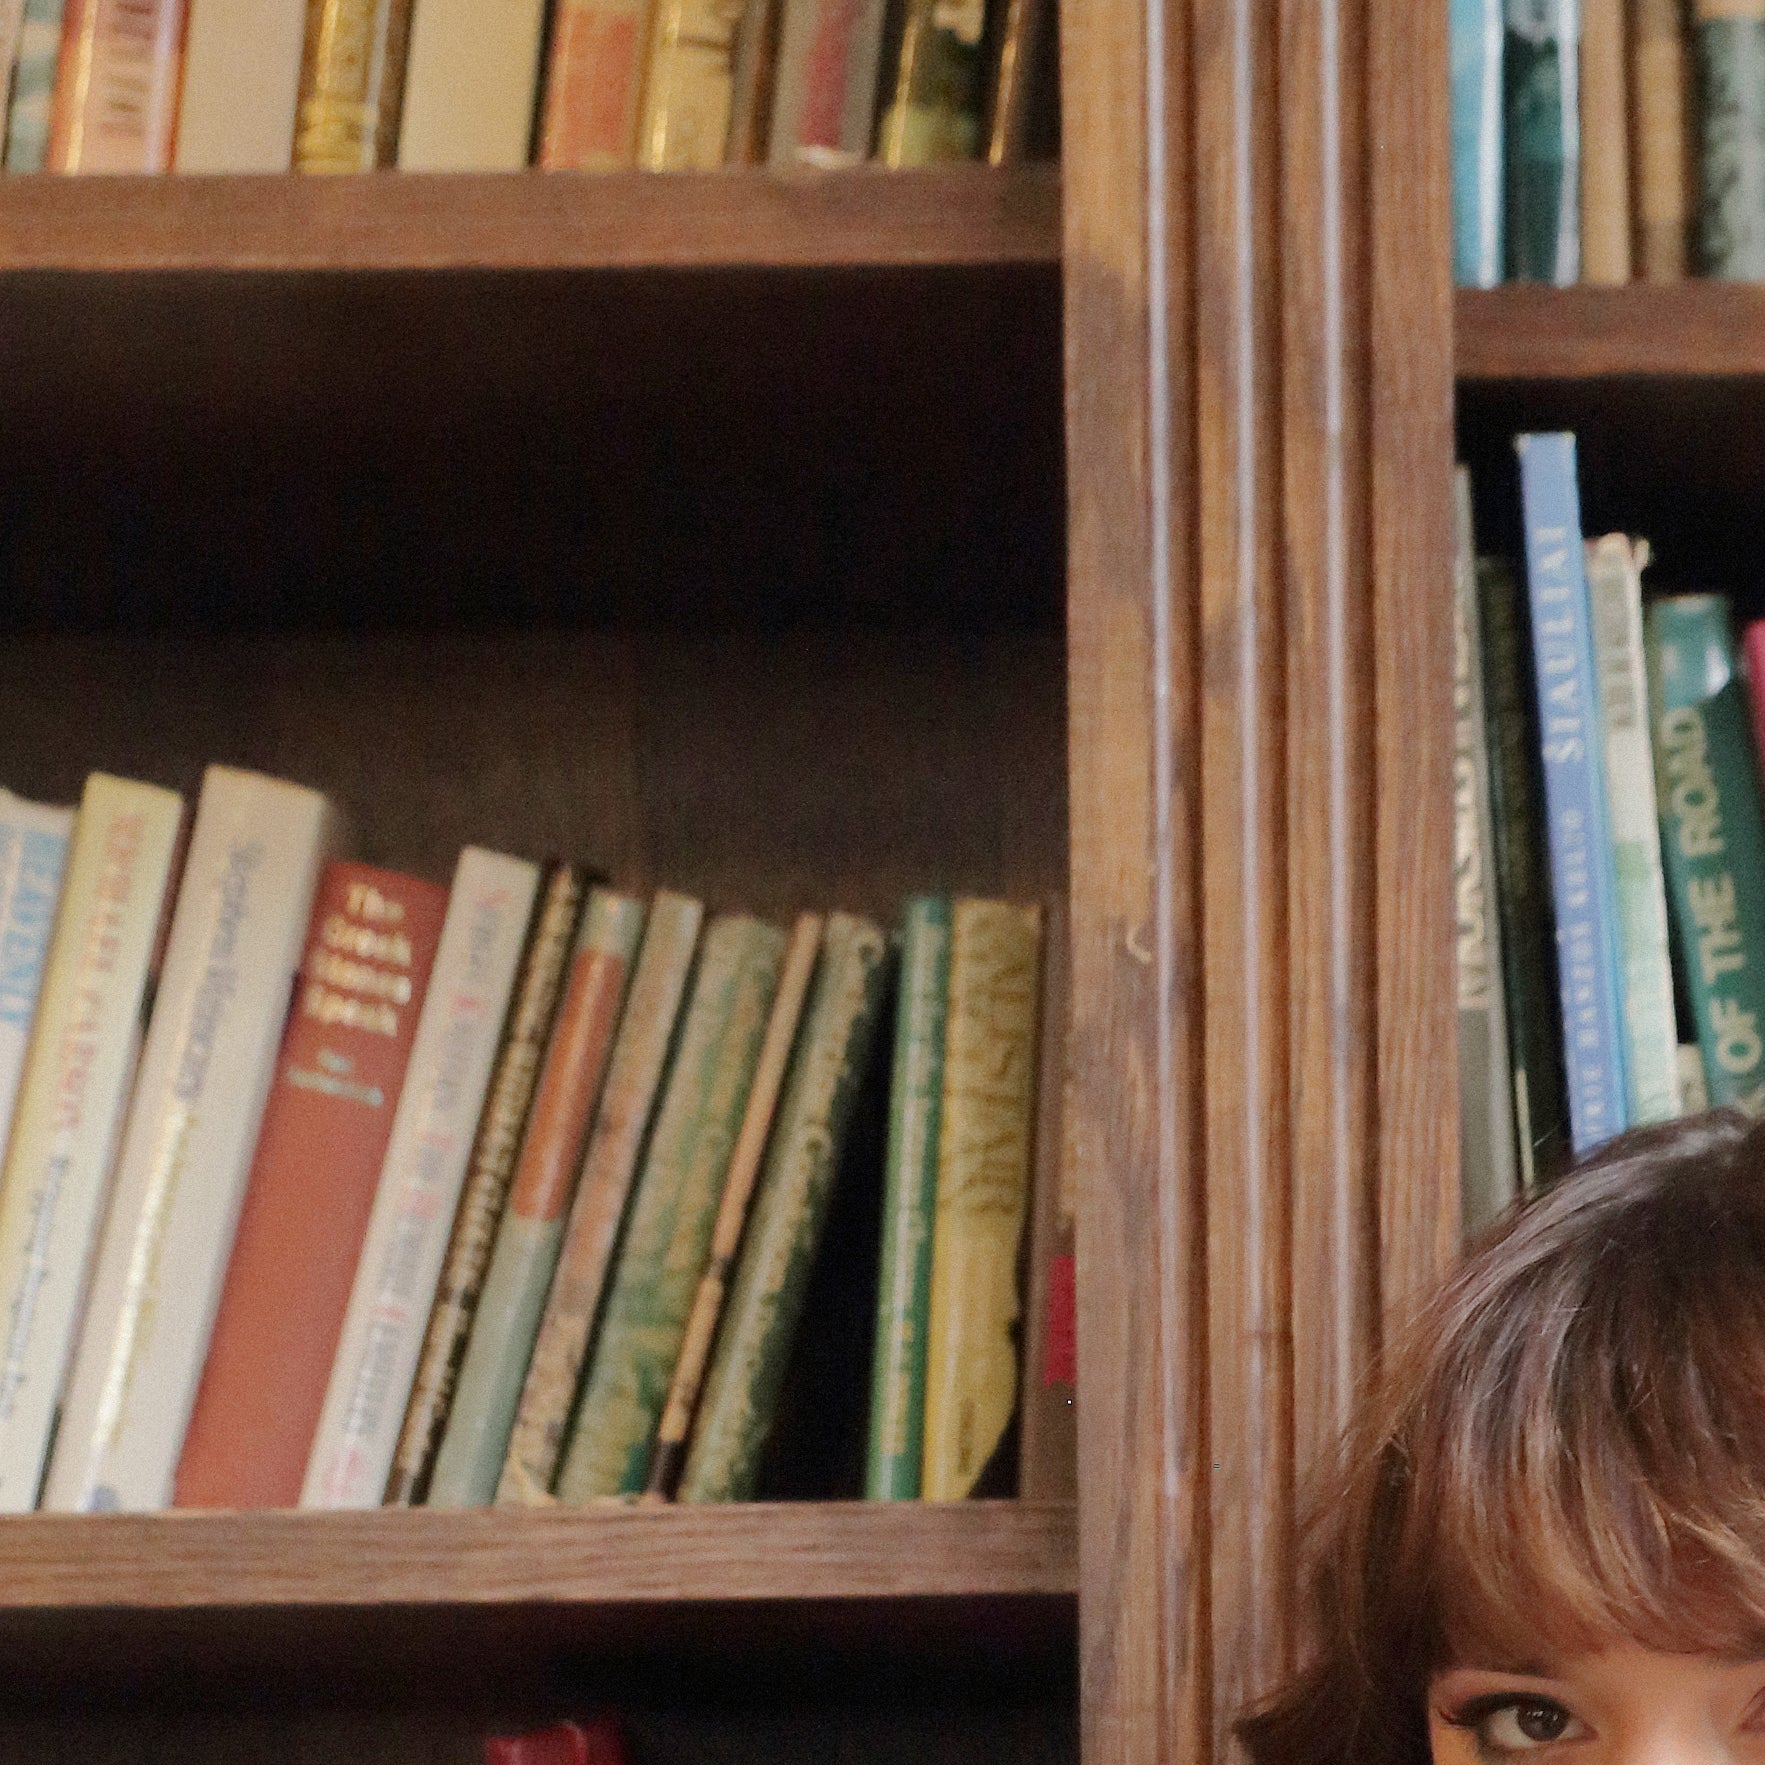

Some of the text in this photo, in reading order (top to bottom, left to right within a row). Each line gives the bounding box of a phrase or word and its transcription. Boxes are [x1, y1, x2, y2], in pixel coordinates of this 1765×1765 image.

[1660, 705, 1728, 859] ROAD
[1689, 873, 1747, 982] THE
[1707, 996, 1764, 1077] OF
